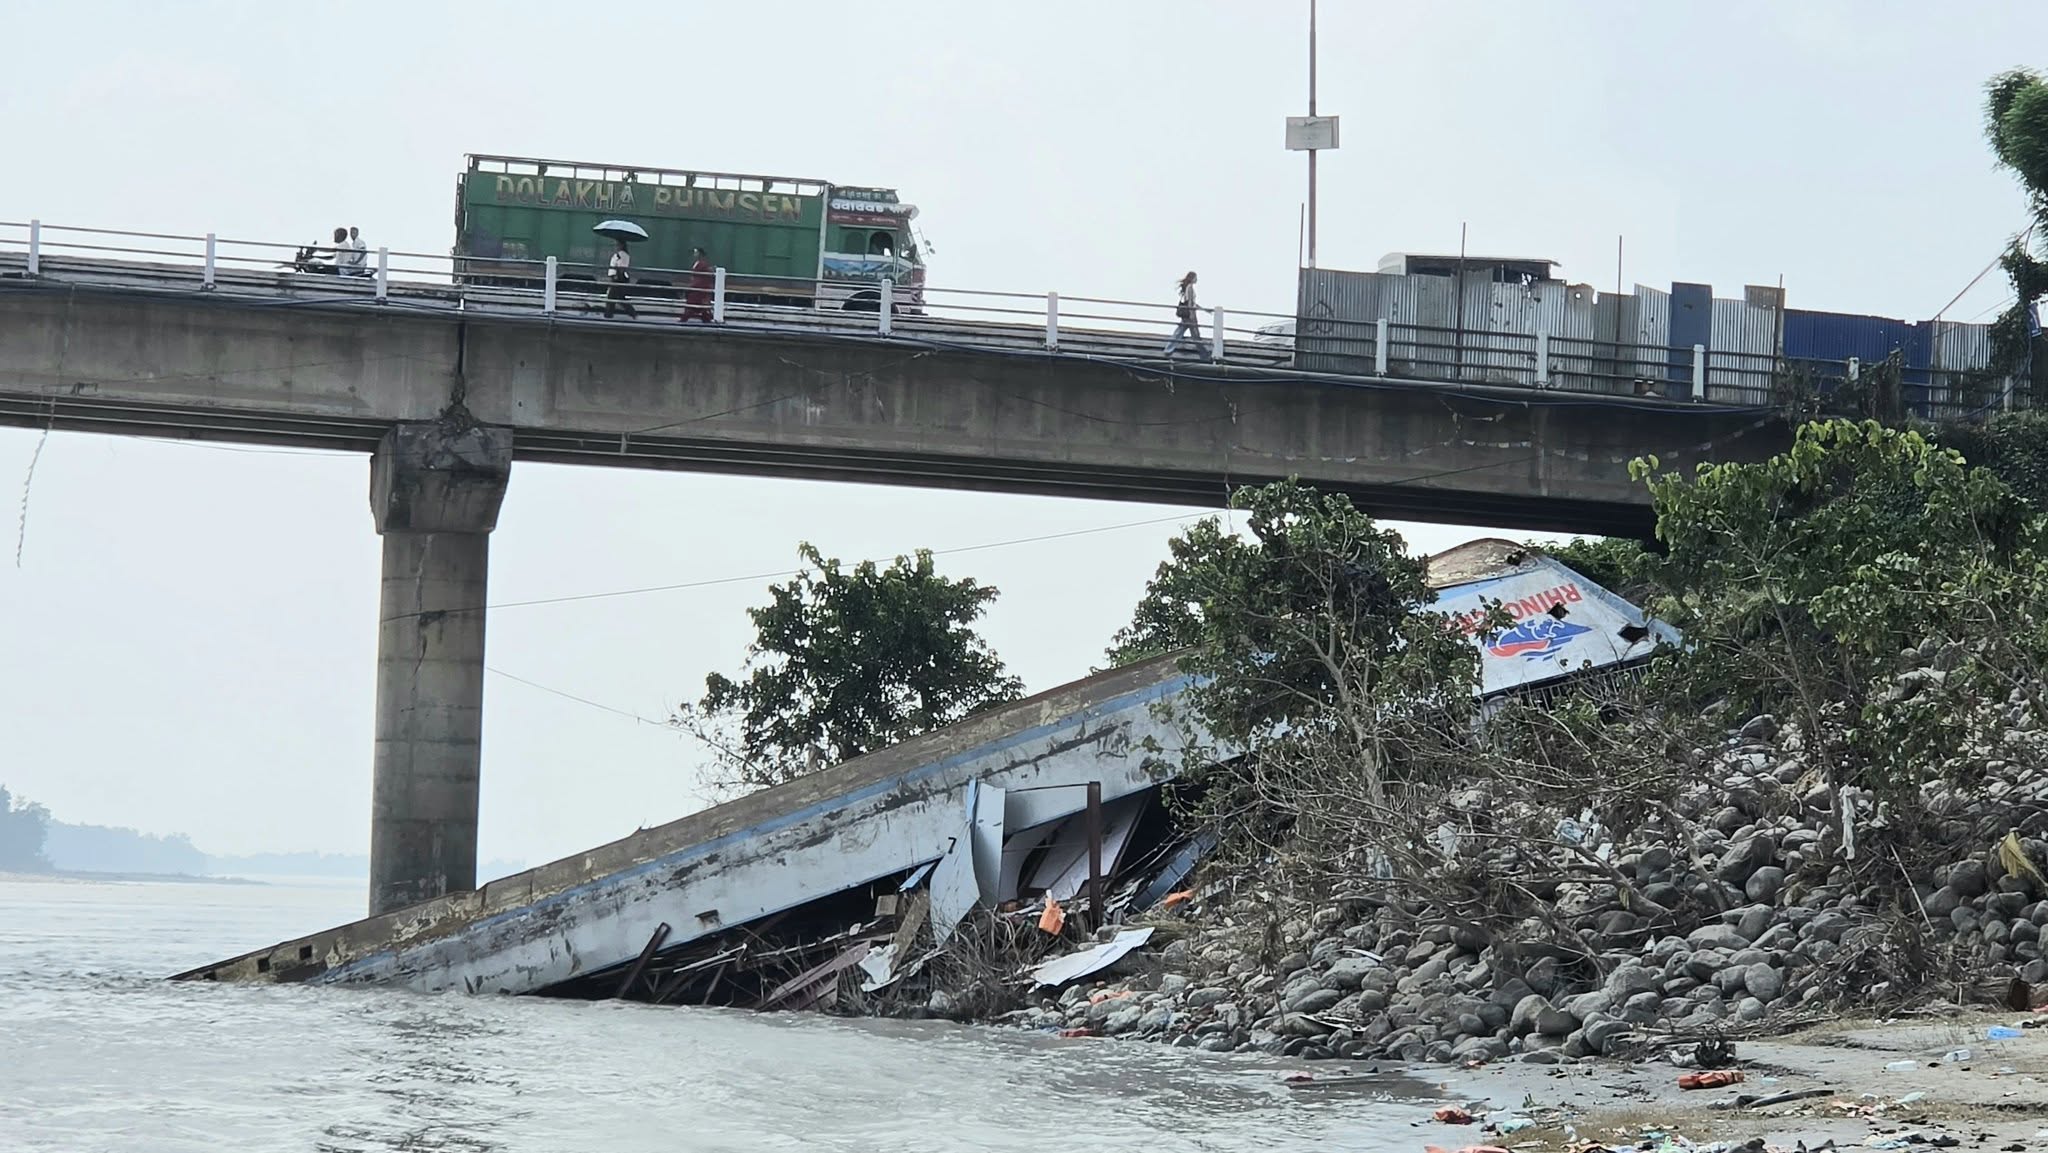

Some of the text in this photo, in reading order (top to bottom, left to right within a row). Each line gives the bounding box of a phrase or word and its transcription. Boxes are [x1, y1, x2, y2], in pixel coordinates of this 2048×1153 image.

[495, 175, 802, 222] DOLAKHA BHIMSEN
[1504, 583, 1583, 619] RHINO
